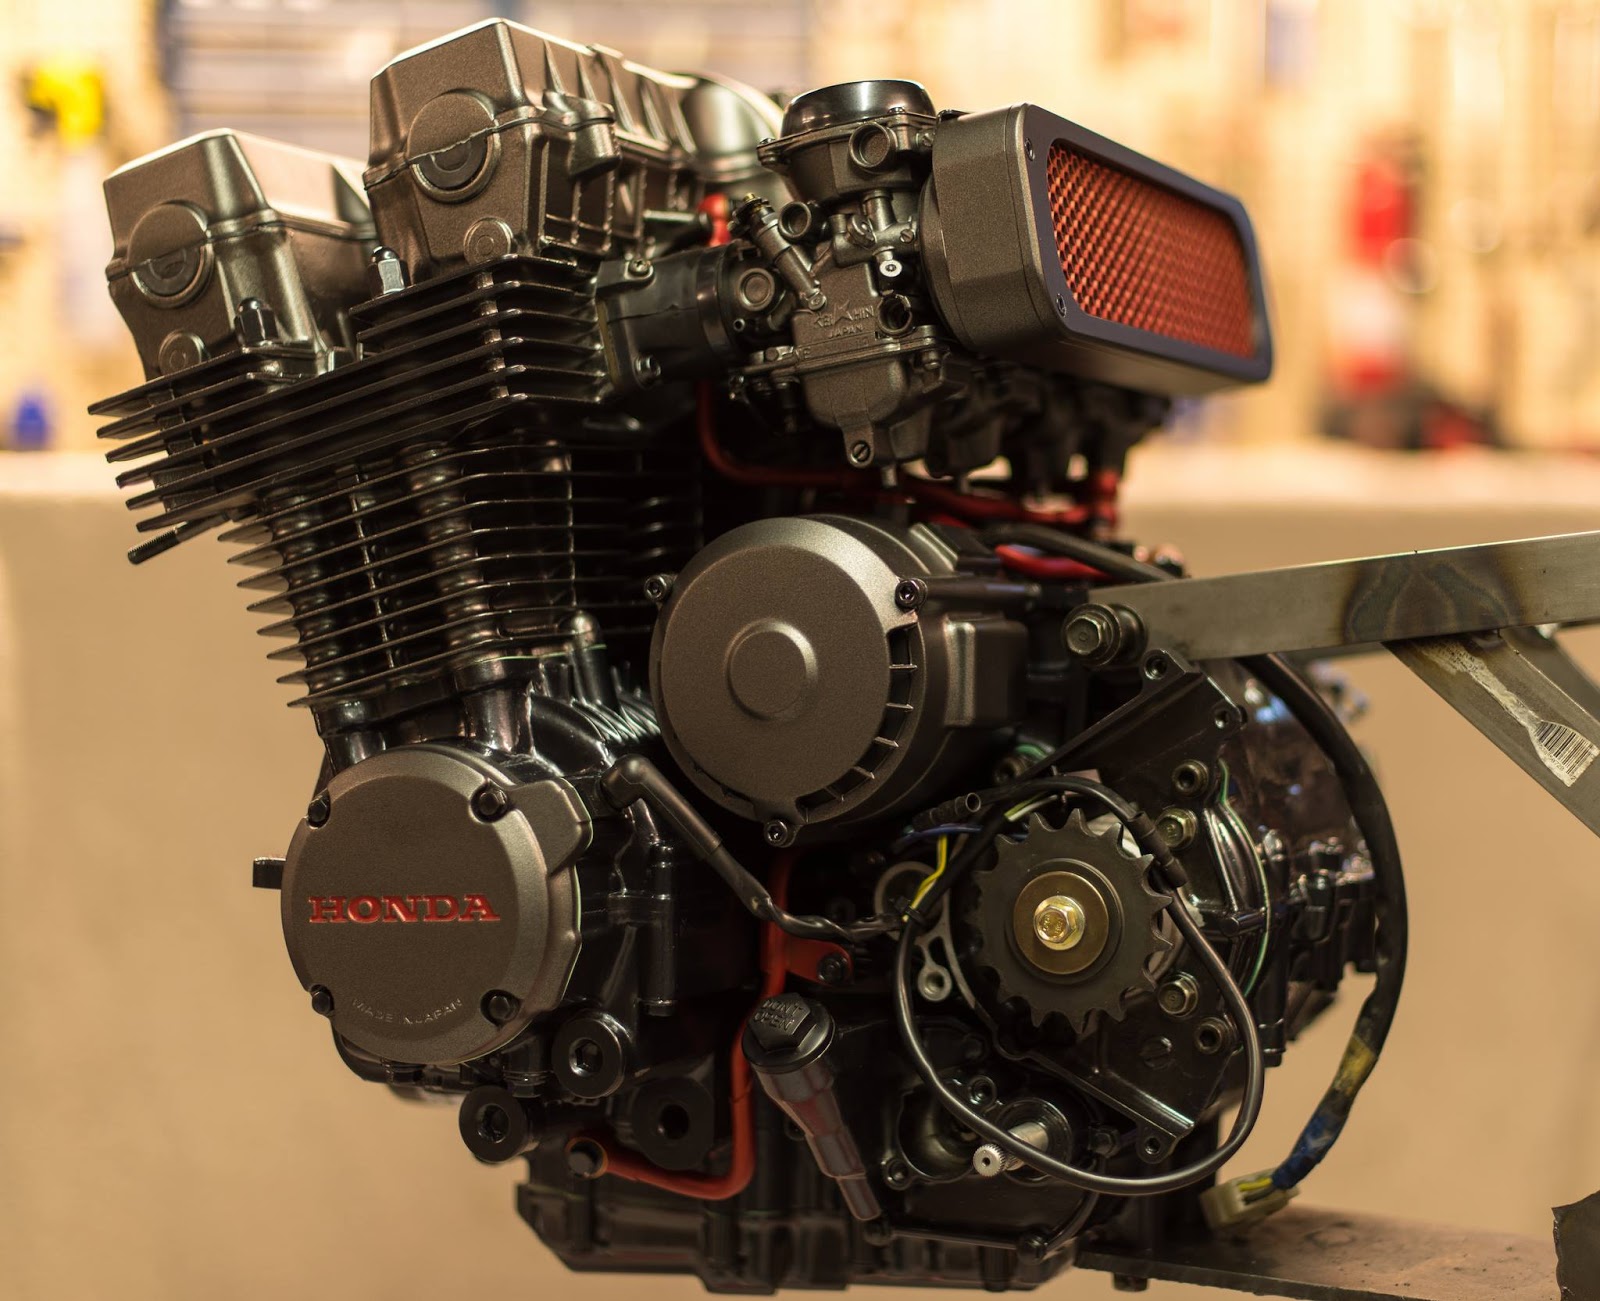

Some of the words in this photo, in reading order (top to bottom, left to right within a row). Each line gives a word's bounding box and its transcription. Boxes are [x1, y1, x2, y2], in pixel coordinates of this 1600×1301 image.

[828, 324, 864, 338] JAPAN
[308, 894, 500, 923] HONDA
[352, 998, 393, 1022] MADE
[415, 997, 462, 1025] JAPAN
[753, 1012, 795, 1030] OPEN
